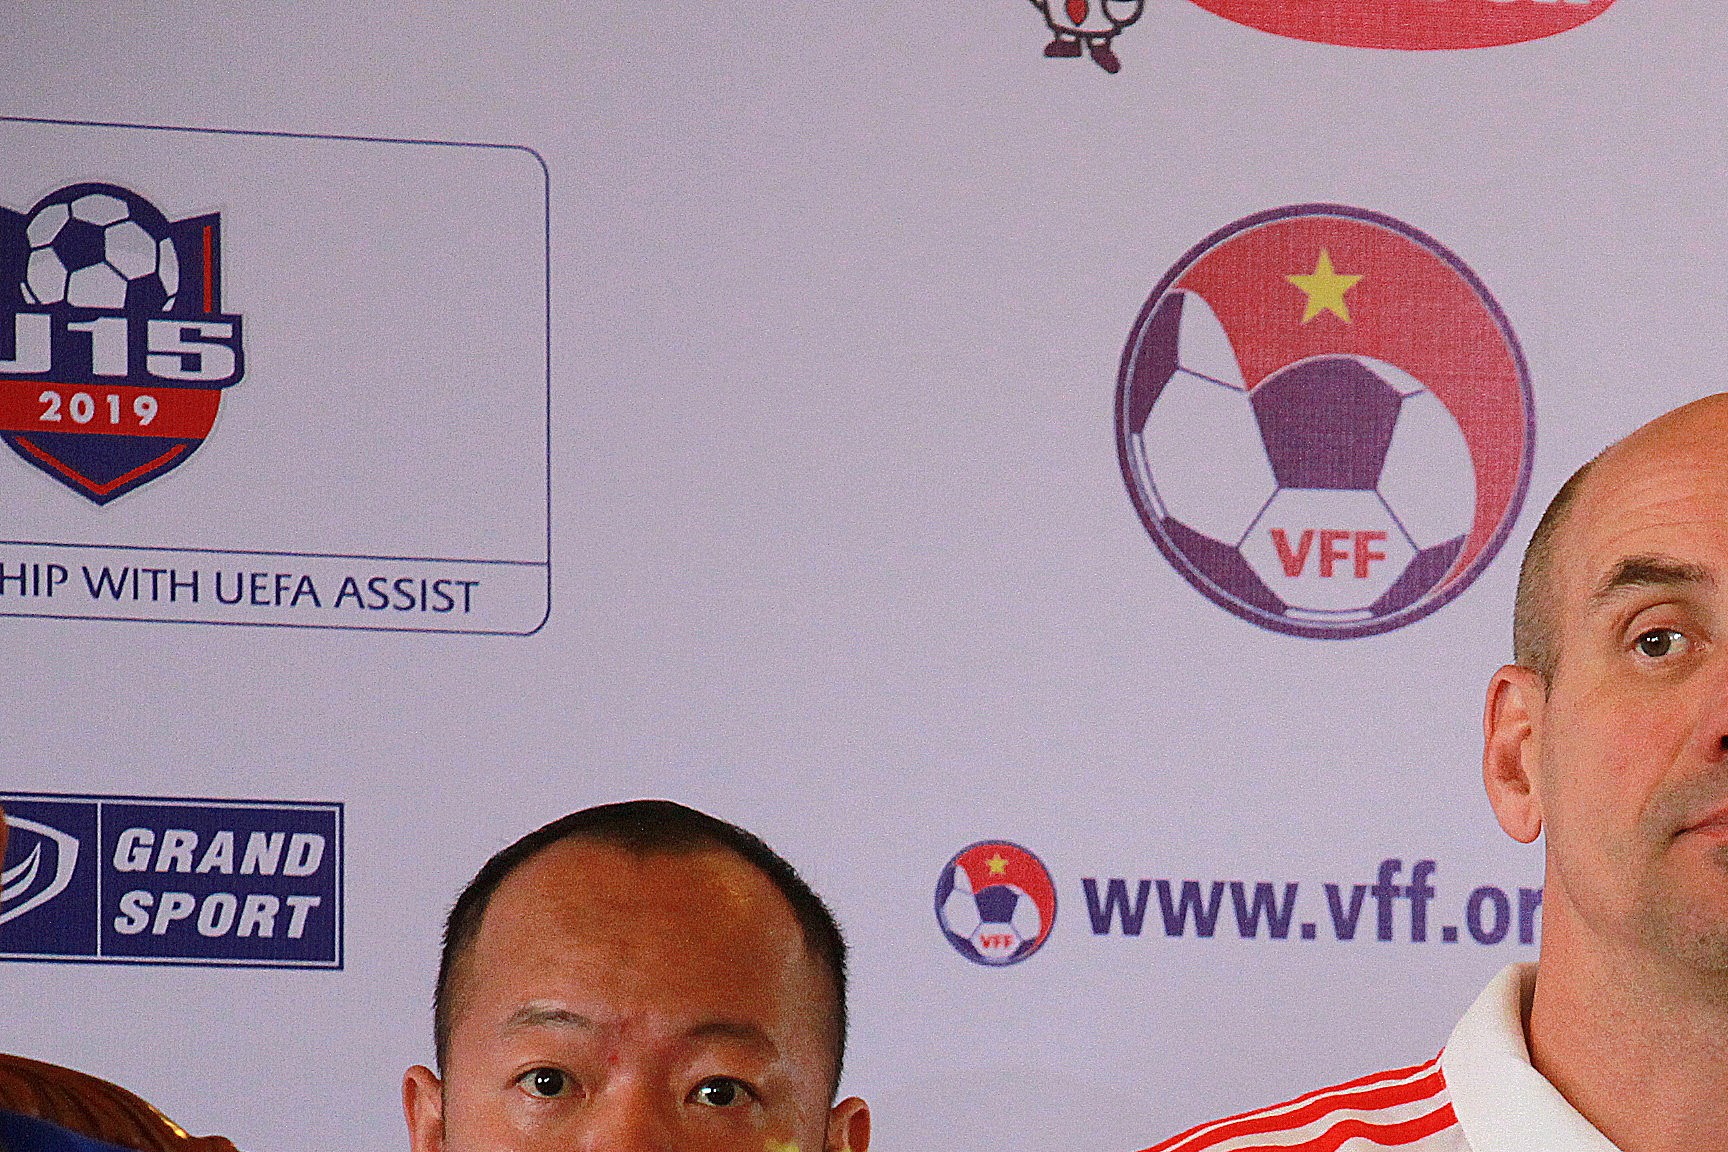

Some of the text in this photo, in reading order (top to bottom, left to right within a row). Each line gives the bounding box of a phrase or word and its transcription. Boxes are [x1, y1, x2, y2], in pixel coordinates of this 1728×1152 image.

[38, 391, 158, 425] 2019
[1270, 528, 1387, 578] VFF
[82, 565, 199, 602] WITH
[215, 571, 321, 608] UEFA
[334, 576, 479, 613] ASSIST
[113, 828, 326, 877] GRAND
[113, 890, 322, 939] SPORT
[980, 934, 1014, 948] VFF
